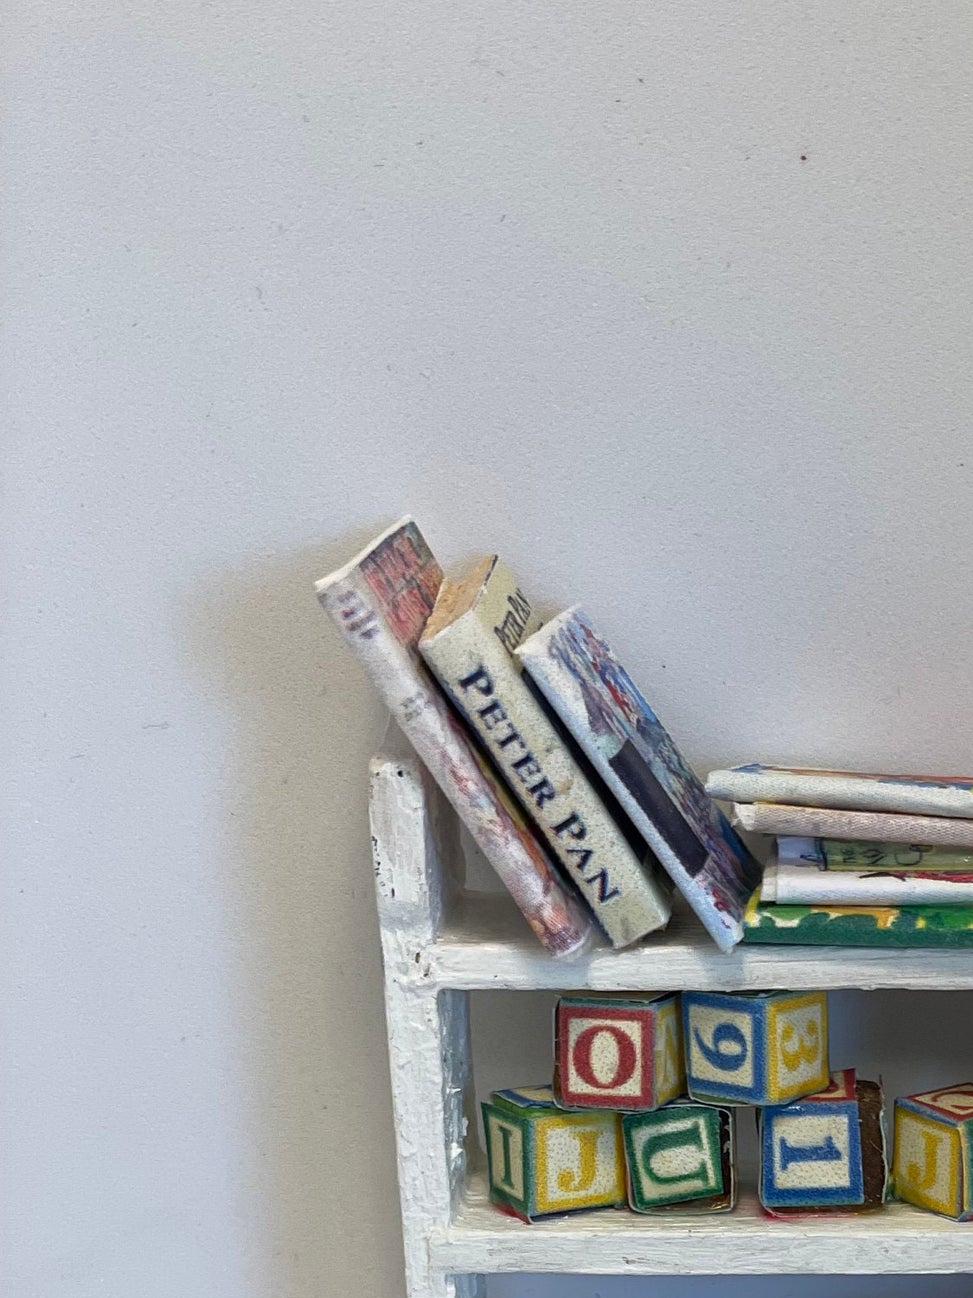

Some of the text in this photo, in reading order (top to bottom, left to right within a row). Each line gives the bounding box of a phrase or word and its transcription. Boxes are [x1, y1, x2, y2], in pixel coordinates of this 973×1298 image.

[458, 664, 623, 906] PETER PAN
[572, 1025, 637, 1090] O
[557, 1131, 599, 1192] J
[905, 1131, 942, 1191] J
